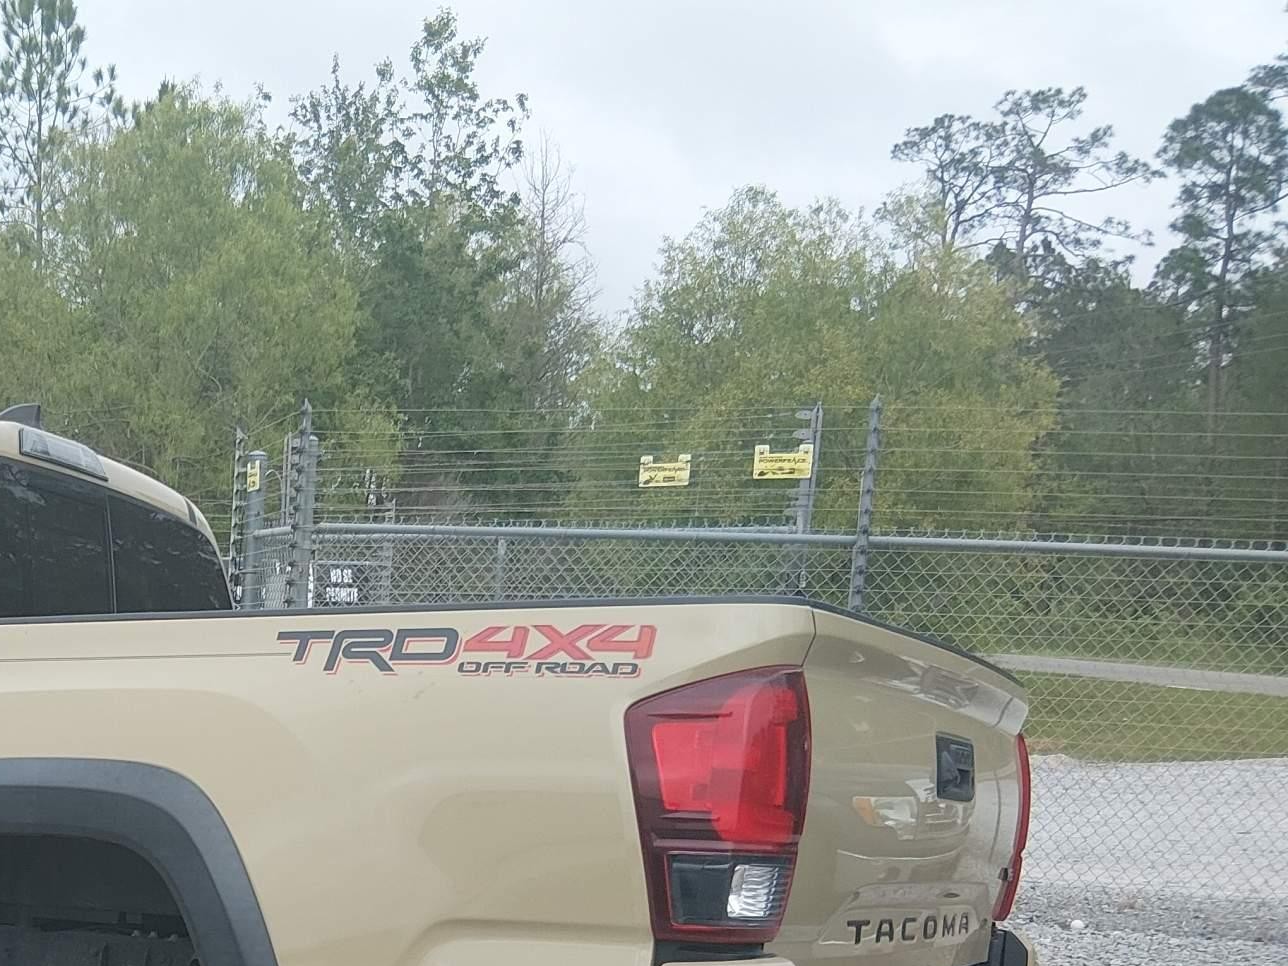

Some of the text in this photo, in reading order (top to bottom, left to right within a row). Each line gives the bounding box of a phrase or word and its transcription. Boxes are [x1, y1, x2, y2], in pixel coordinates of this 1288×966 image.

[277, 624, 657, 675] TRD 4X4
[457, 661, 643, 678] OFF ROAD
[847, 912, 969, 944] TACOMA
